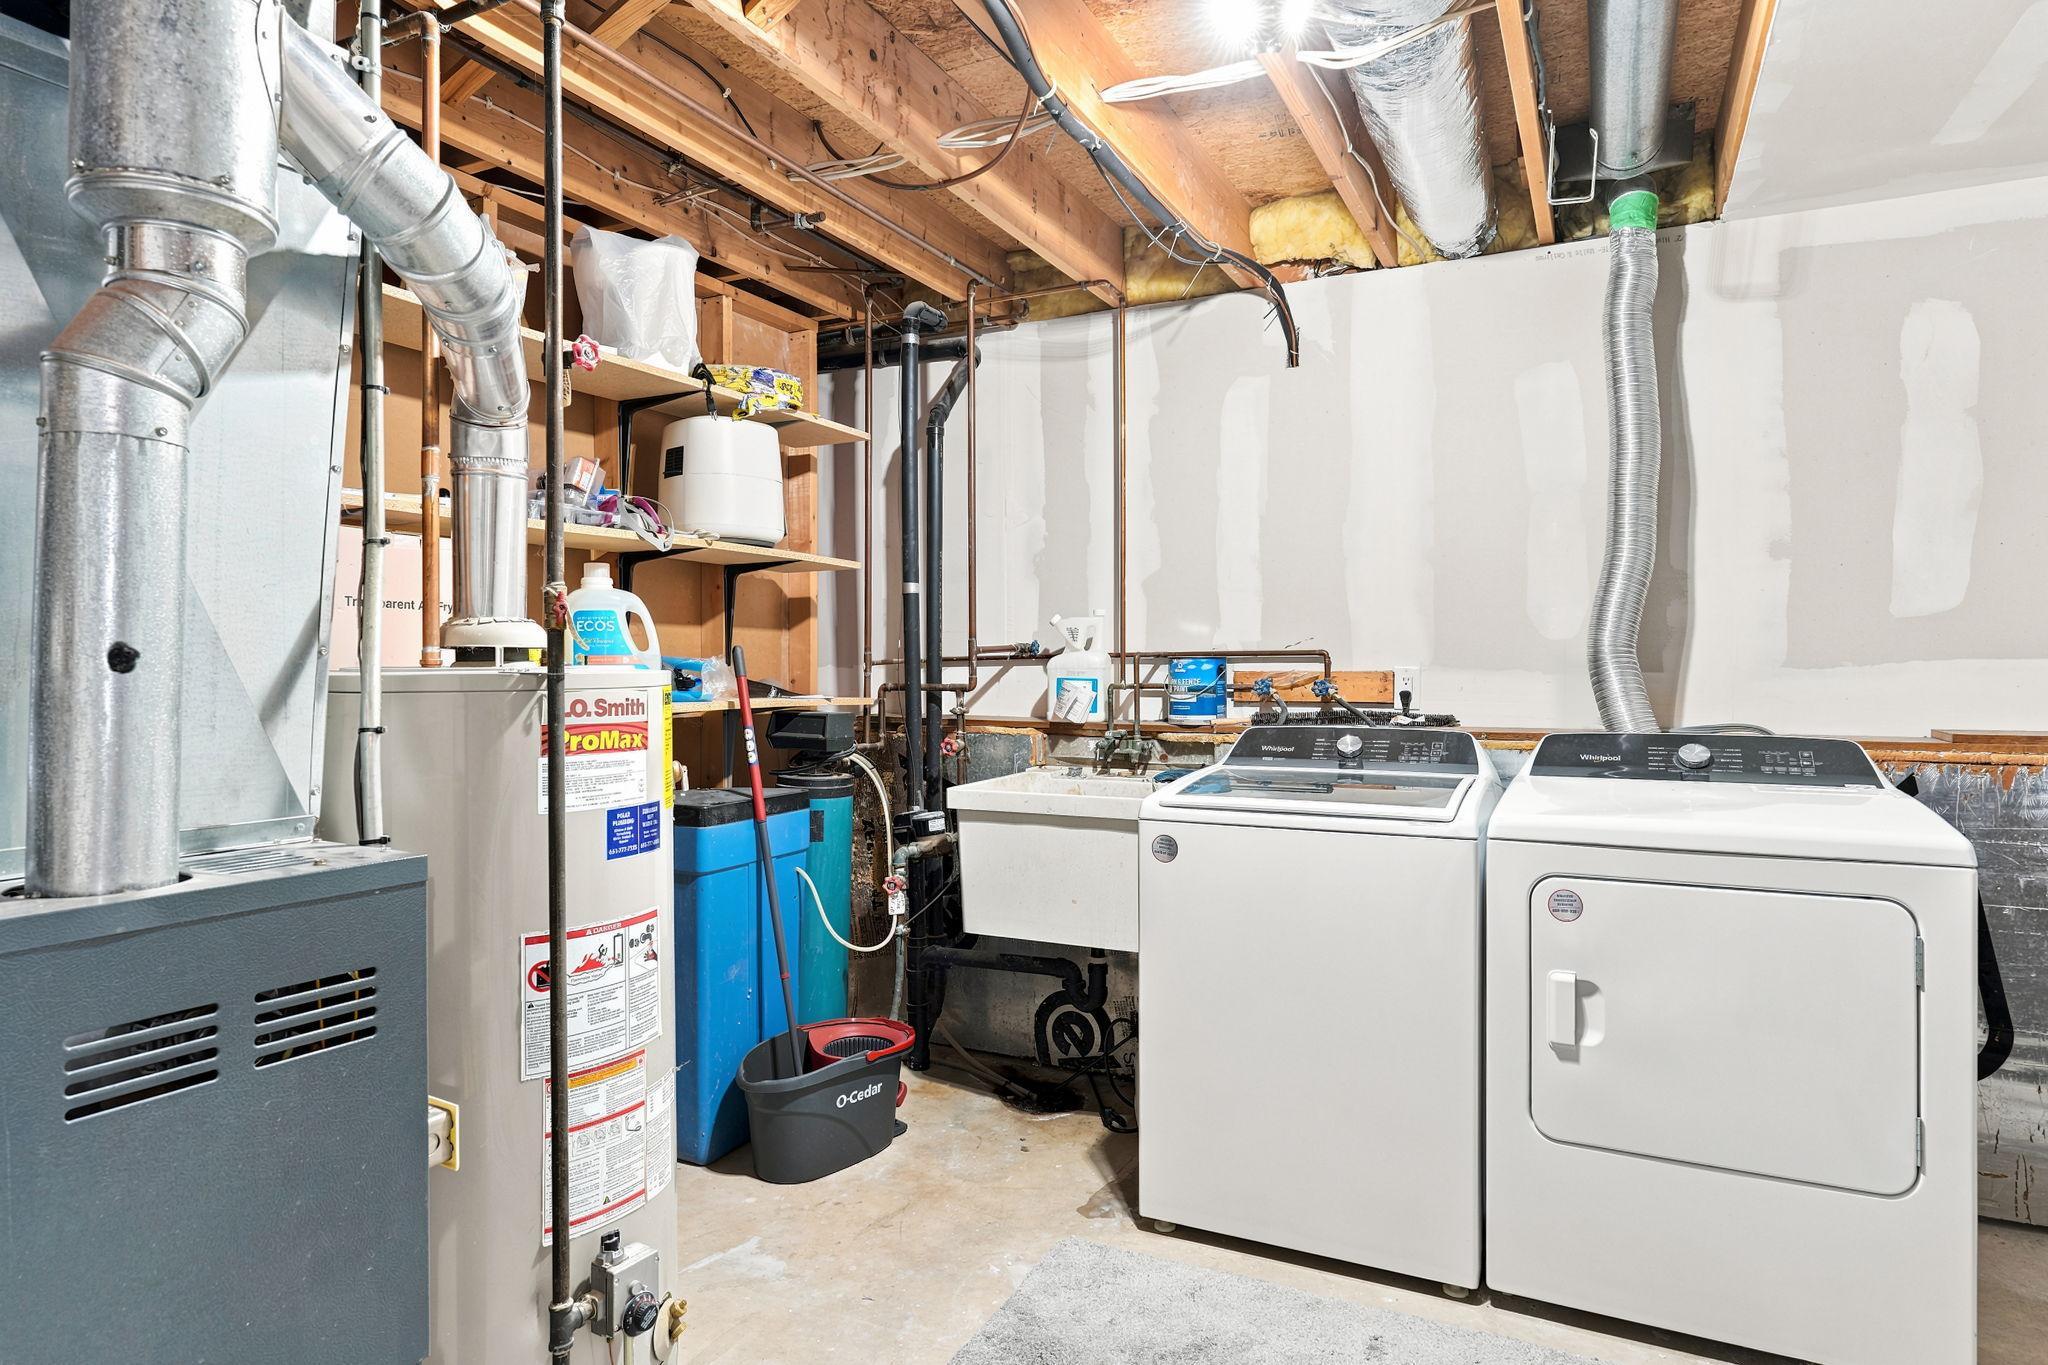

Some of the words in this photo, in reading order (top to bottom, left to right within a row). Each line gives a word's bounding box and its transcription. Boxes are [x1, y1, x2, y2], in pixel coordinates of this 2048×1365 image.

[344, 595, 415, 610] Trarent
[576, 620, 615, 632] ECOS
[565, 698, 592, 718] .O.
[593, 697, 645, 718] Smith
[1261, 745, 1295, 753] Whirlpool
[1579, 753, 1621, 763] Whirlpool
[593, 922, 622, 934] DANGER
[836, 1082, 883, 1108] O-Cedar
